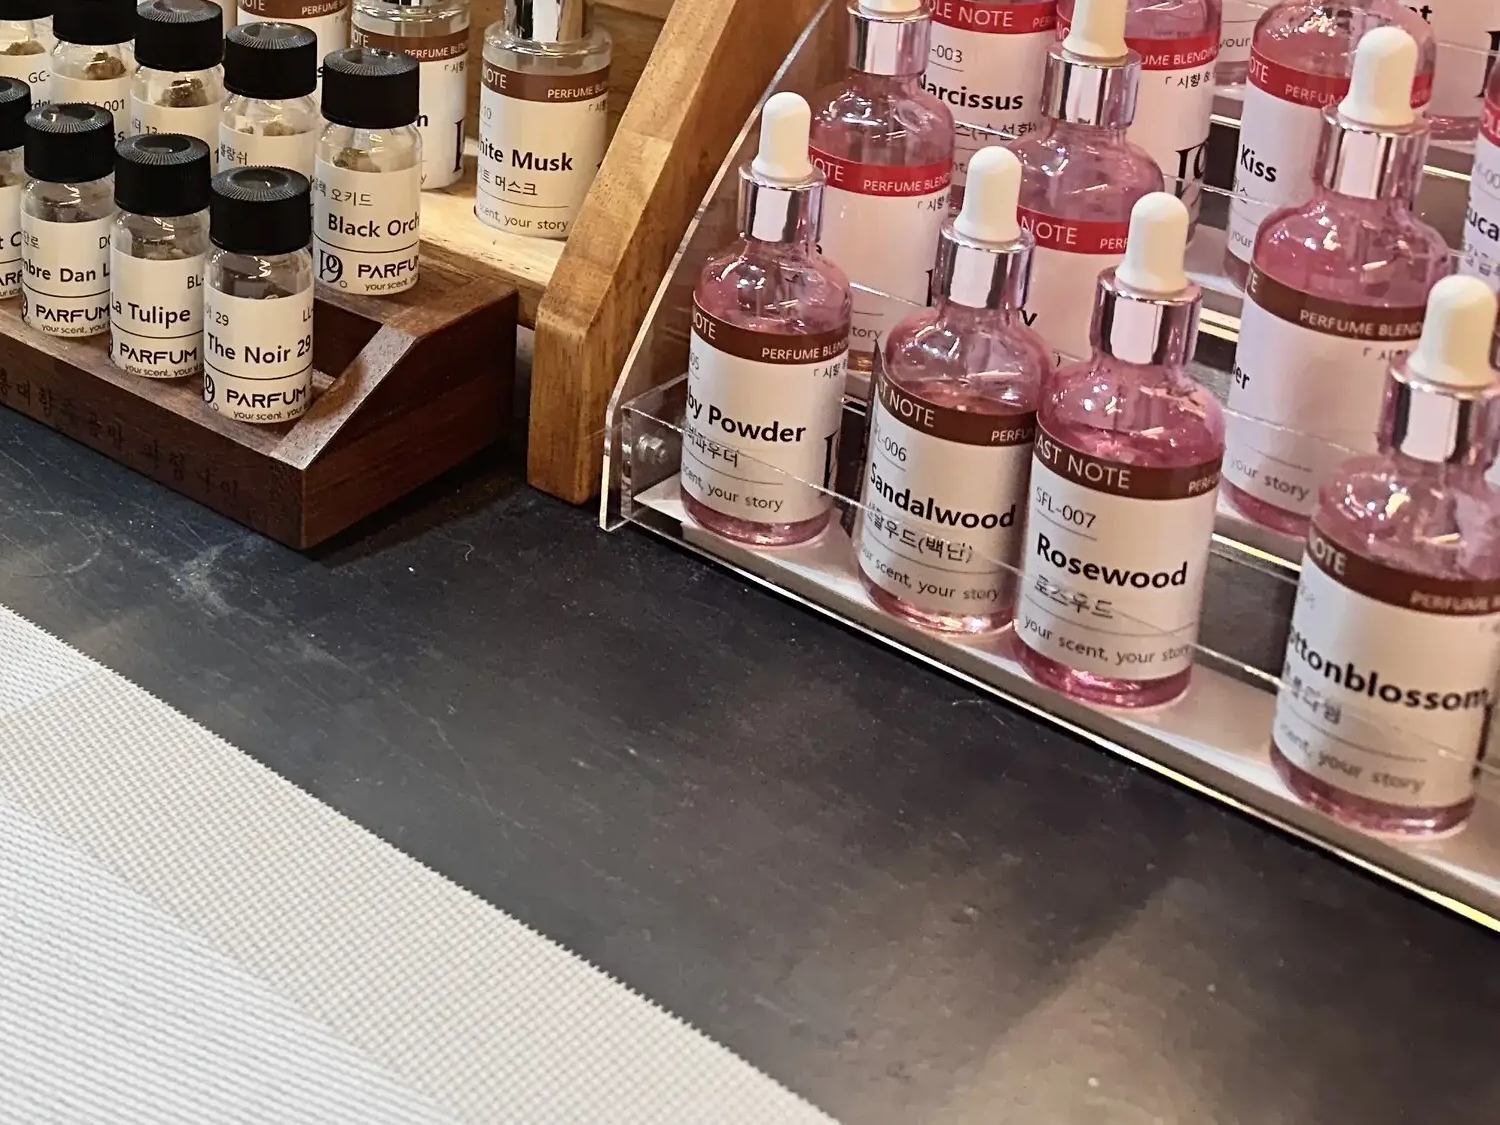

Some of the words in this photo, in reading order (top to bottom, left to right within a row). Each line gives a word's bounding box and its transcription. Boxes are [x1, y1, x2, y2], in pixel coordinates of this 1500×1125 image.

[959, 6, 1014, 28] NOTE
[404, 46, 449, 59] PERFUME
[1178, 72, 1201, 89] 시향
[1249, 61, 1269, 84] OTE
[547, 84, 594, 99] PERFUME
[511, 149, 574, 172] Musk
[331, 187, 373, 207] 오키드
[495, 175, 539, 196] 머스크
[863, 178, 922, 193] PERFUME
[328, 212, 381, 238] Black
[387, 211, 420, 236] Orch
[504, 214, 533, 229] your
[537, 219, 569, 232] story
[1020, 215, 1078, 246] NOTE
[59, 267, 96, 283] Dan
[36, 303, 110, 324] PARFUM
[127, 301, 191, 329] Tulipe
[1299, 308, 1374, 336] PERFUME
[852, 325, 884, 341] tory
[120, 341, 198, 365] PARFUM
[207, 332, 236, 360] The
[244, 345, 291, 364] Noir
[296, 334, 312, 358] 29
[761, 346, 820, 361] PERFUME
[226, 385, 307, 409] PARFUM
[233, 409, 254, 422] your
[889, 390, 935, 429] NOTE
[708, 404, 807, 443] Powder
[1068, 453, 1133, 490] NOTE
[707, 481, 740, 503] your
[745, 495, 784, 513] story
[870, 462, 1016, 530] Sandalwood
[1263, 473, 1311, 502] story
[1035, 486, 1097, 530] SFL-007
[1036, 532, 1189, 589] Rosewood
[875, 553, 912, 588] scent,
[916, 579, 957, 600] your
[1023, 615, 1053, 641] your
[1058, 635, 1109, 663] scent,
[1116, 648, 1155, 666] your
[1370, 769, 1426, 795] story
